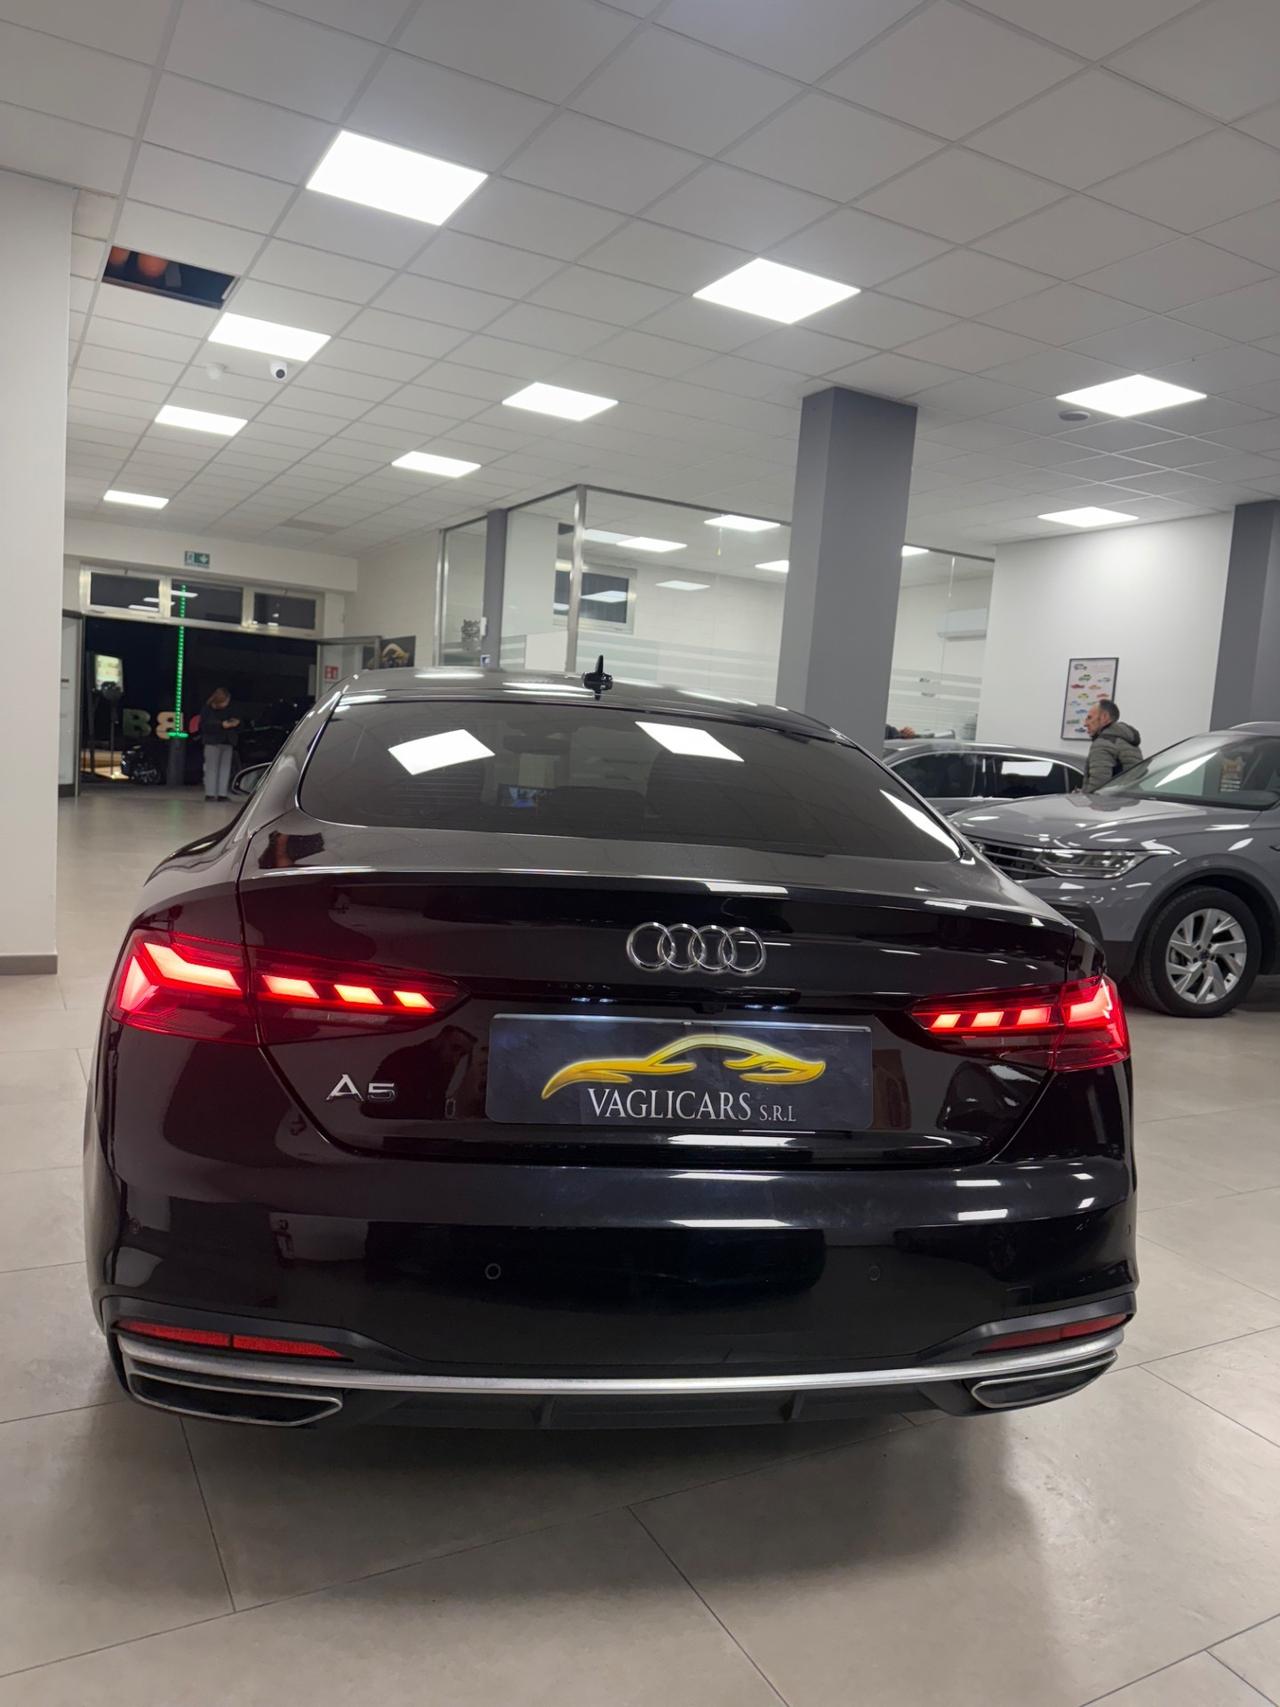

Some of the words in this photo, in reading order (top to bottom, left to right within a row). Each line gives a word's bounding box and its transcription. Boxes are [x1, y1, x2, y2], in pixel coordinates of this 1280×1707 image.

[326, 1073, 396, 1101] A5
[587, 1087, 752, 1121] VAGLICARS
[759, 1104, 797, 1122] S.R.L
